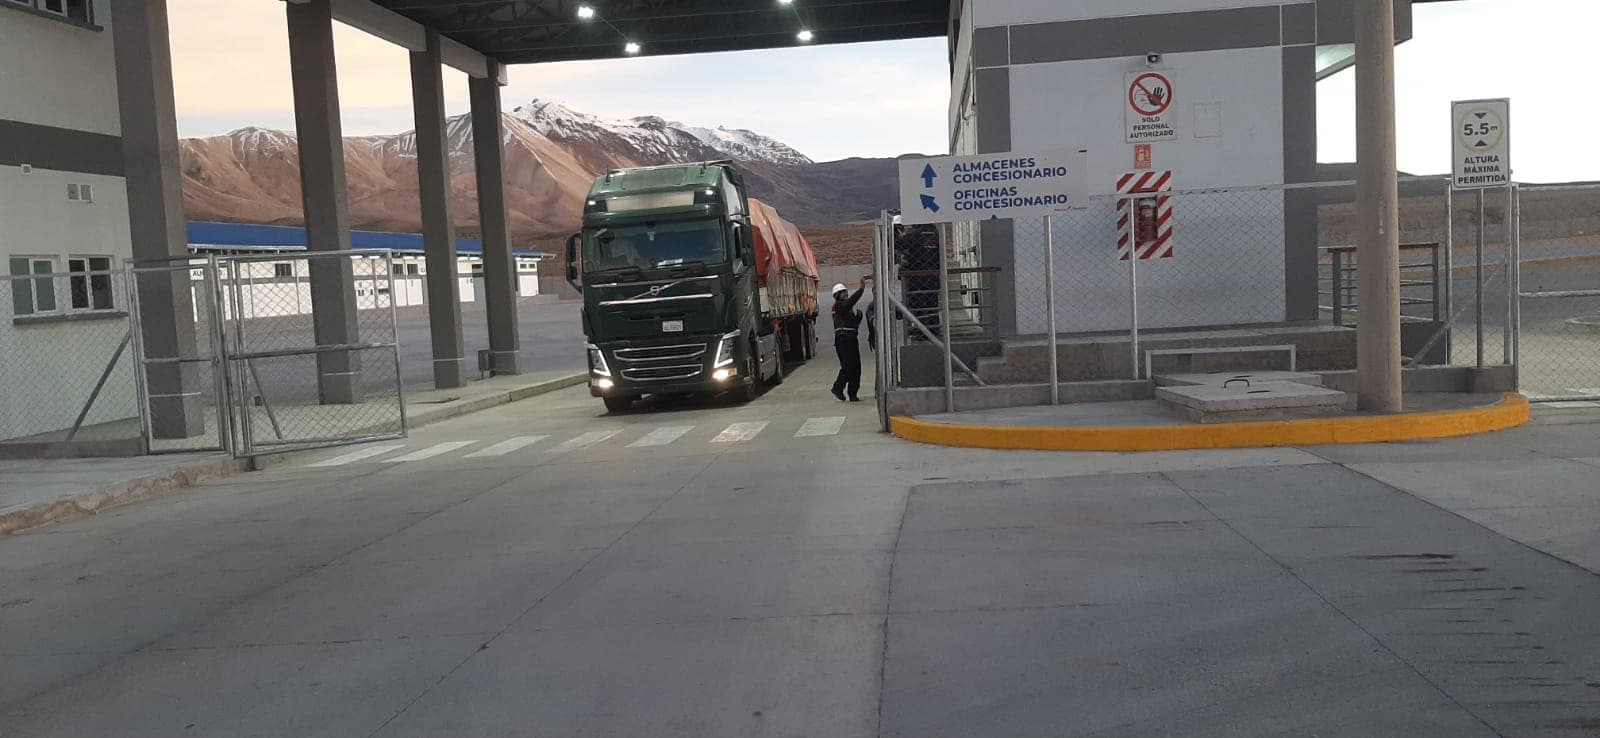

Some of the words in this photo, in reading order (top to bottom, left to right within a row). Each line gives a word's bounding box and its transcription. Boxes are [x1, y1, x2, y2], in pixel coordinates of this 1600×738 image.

[1132, 123, 1170, 131] PERSONAL
[1129, 130, 1174, 138] AUTORIZADO
[952, 157, 1036, 173] ALMACENES
[1464, 155, 1500, 164] ALTURA
[952, 166, 1067, 184] CONCESIONARIO
[1458, 174, 1506, 184] PERMITIDA
[953, 186, 1018, 200] OFICINAS
[954, 194, 1068, 211] CONCESIONARIO
